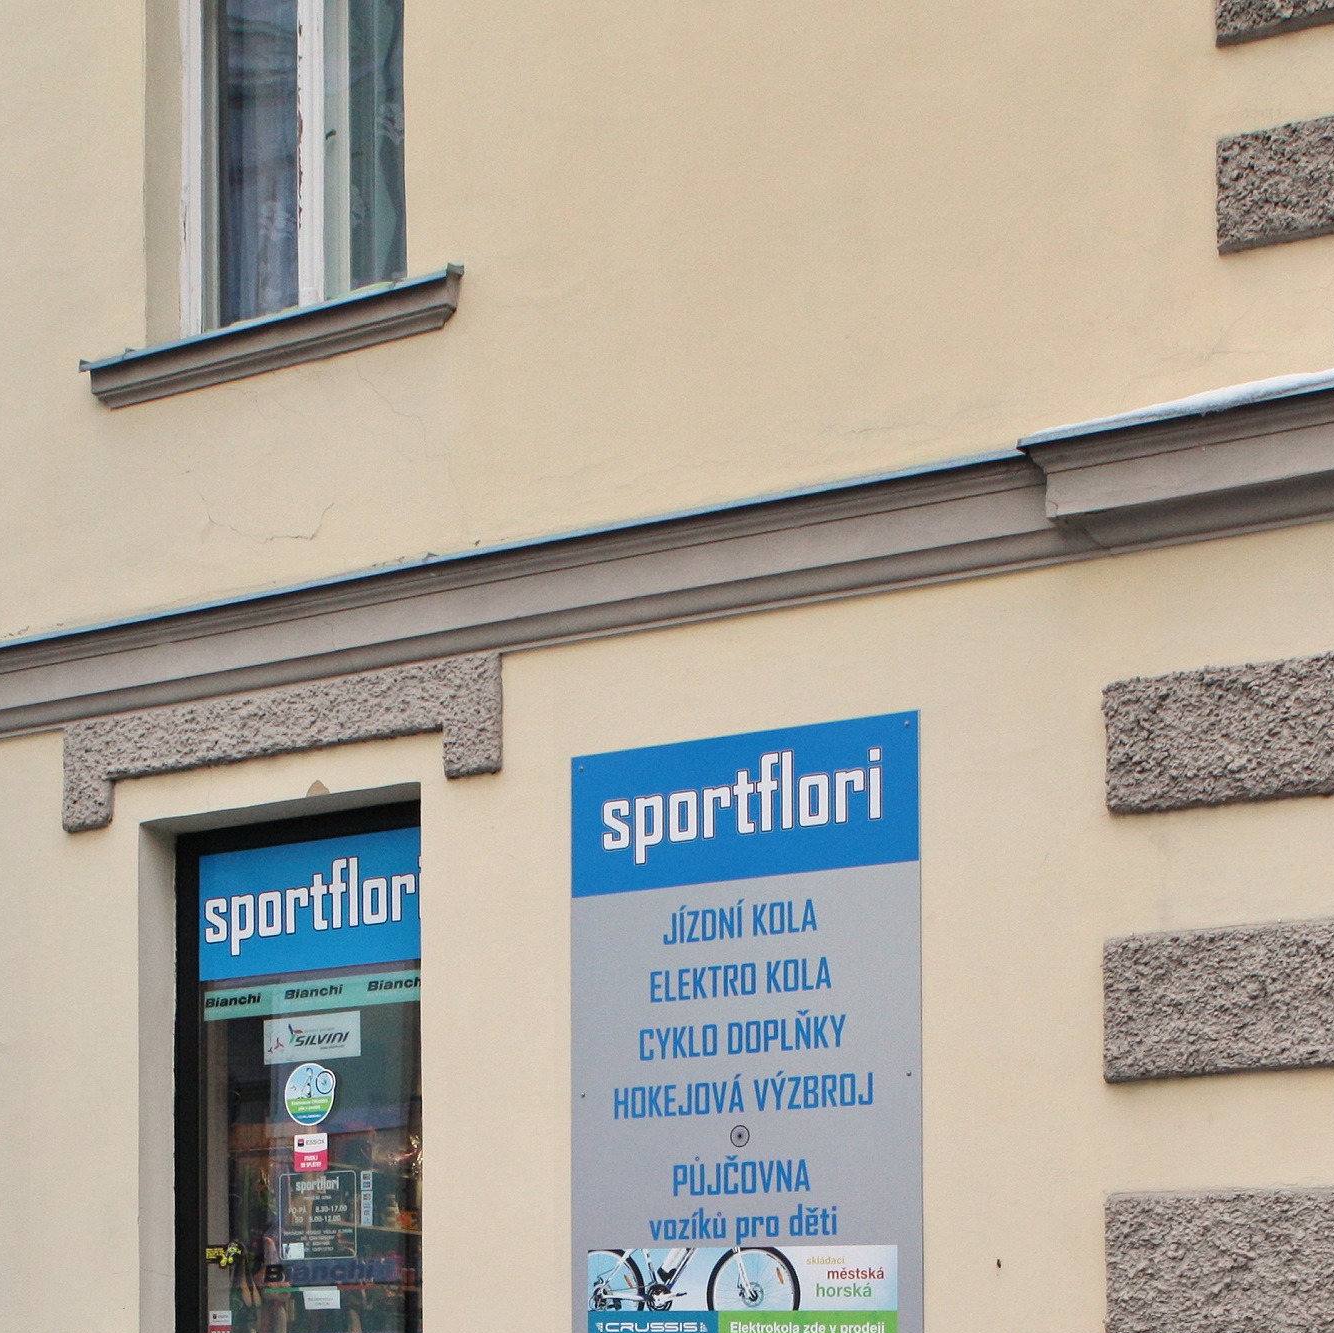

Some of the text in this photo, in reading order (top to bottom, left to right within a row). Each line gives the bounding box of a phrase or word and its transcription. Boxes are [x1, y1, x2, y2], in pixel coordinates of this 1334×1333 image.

[602, 747, 882, 866] sportflori
[204, 856, 422, 956] sportflor
[663, 898, 818, 945] JÍZDNÍ KOLA
[205, 993, 261, 1009] Bianchi
[284, 984, 343, 1000] Bianchi
[650, 956, 832, 1003] ELEKTRO KOLA
[294, 1031, 350, 1047] SILVINI
[639, 1009, 846, 1061] CYKLO DOPLŇKY
[614, 1070, 874, 1120] HOKEJOVÁ VÝZBROJ
[673, 1155, 810, 1197] PŮJČOVNA
[649, 1203, 837, 1245] vozíků pro děti
[806, 1256, 845, 1266] skládací
[827, 1266, 884, 1280] městská
[816, 1283, 872, 1298] horská
[605, 1322, 698, 1333] CRUSSIS
[730, 1322, 800, 1333] Elektrokola
[828, 1325, 837, 1333] v
